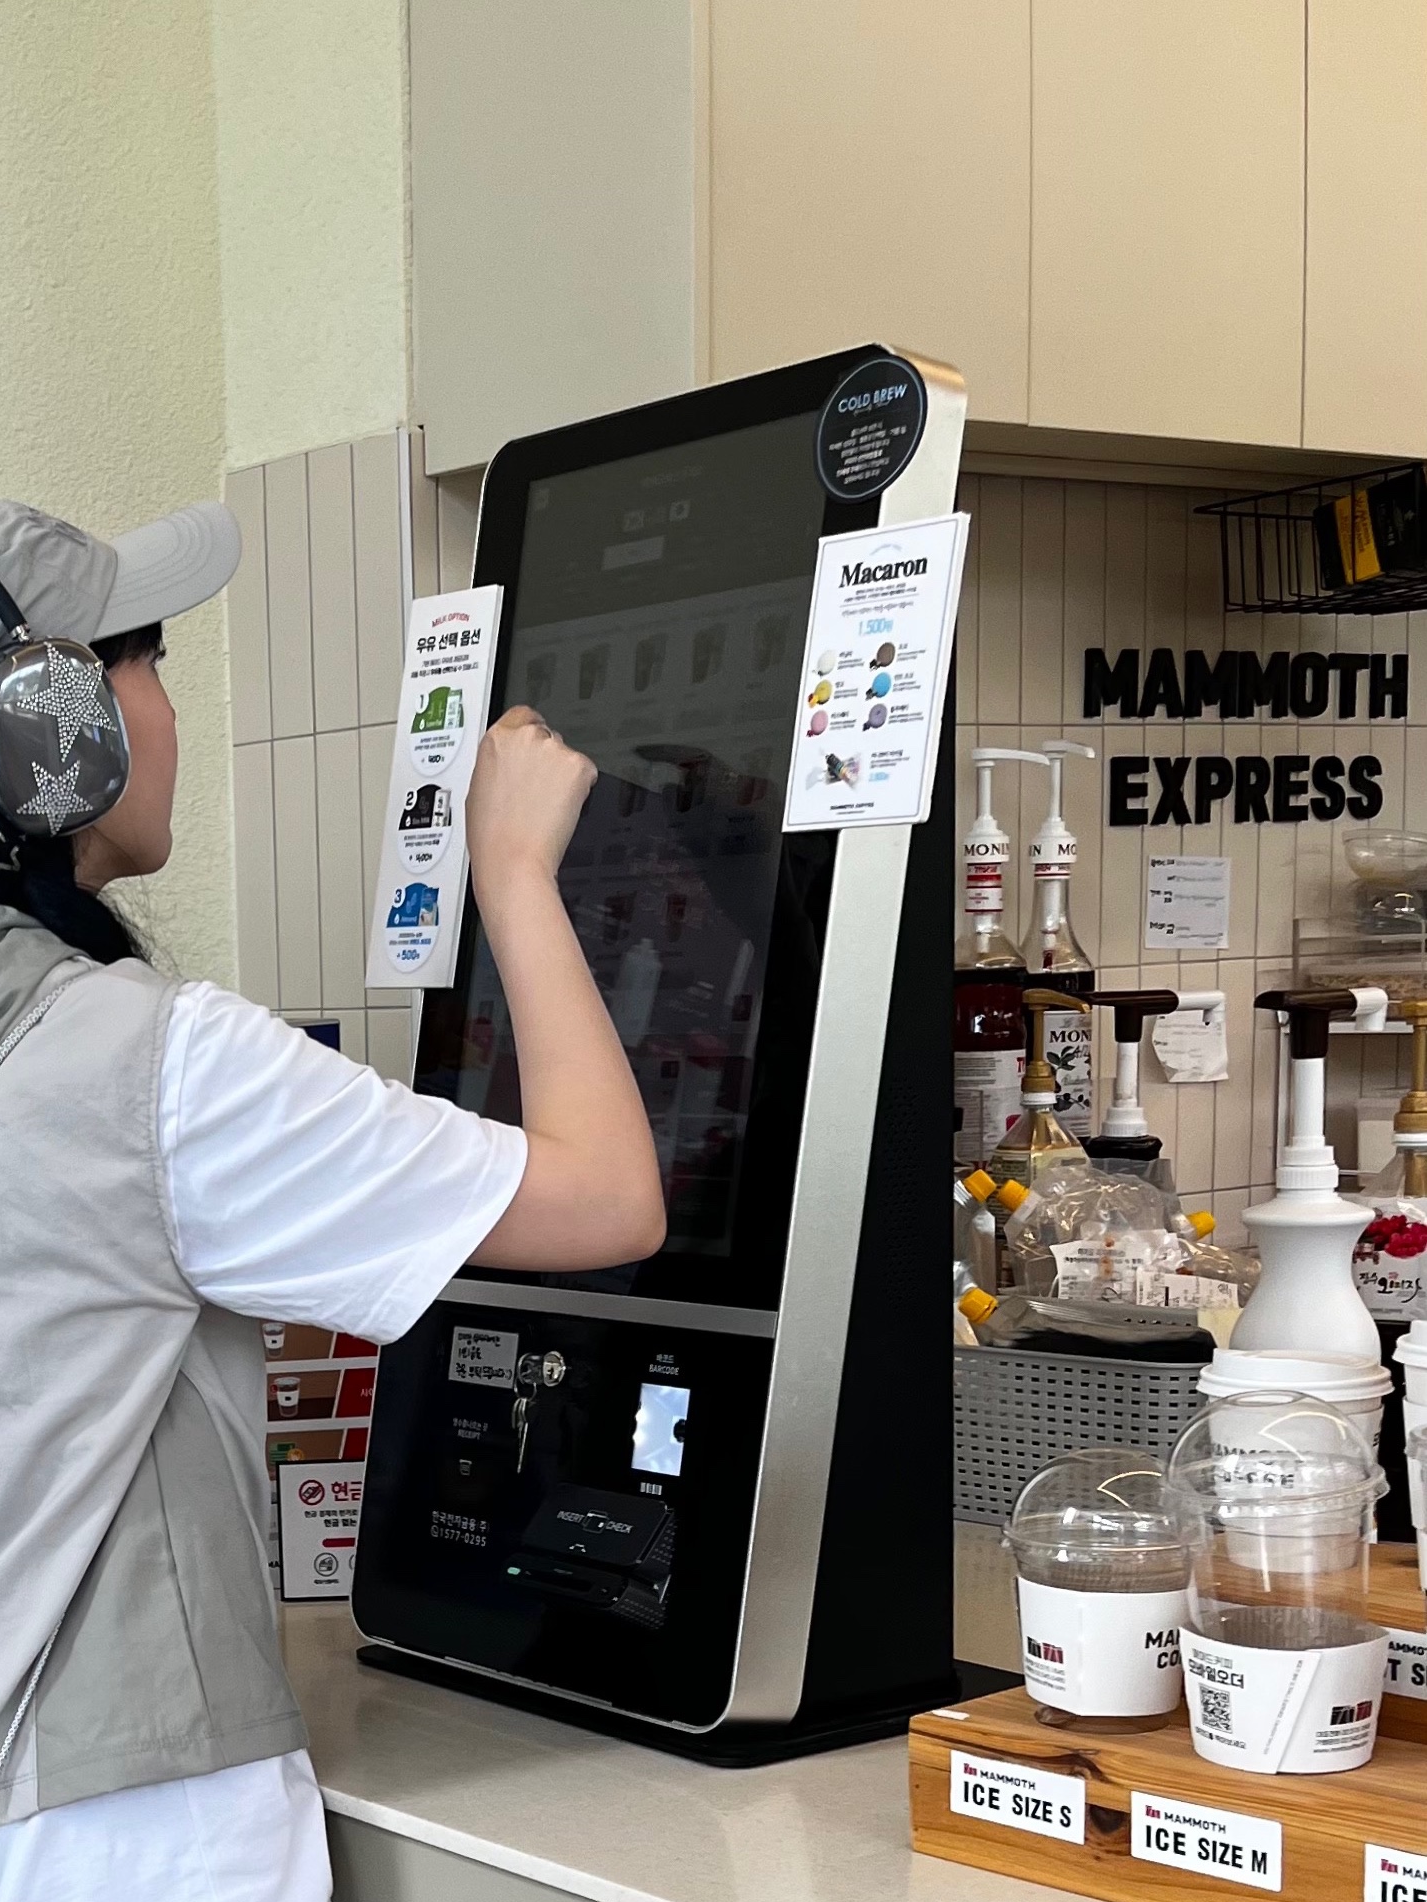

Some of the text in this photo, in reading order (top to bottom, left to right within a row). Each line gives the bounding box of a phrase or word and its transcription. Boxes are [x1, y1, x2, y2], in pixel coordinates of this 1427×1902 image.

[837, 383, 908, 413] COLD BREW
[838, 557, 928, 588] Macaron
[416, 627, 482, 654] 우유 선택 옵션
[1082, 648, 1409, 720] MAMMOTH
[405, 791, 415, 807] 2
[1109, 754, 1384, 827] EXPRESS
[393, 888, 403, 904] 3
[979, 1769, 1036, 1791] MAMMOTH
[963, 1780, 1072, 1828] ICE SIZE S
[1164, 1811, 1226, 1834] MAMMOTH
[1145, 1824, 1268, 1875] ICE SIZE M
